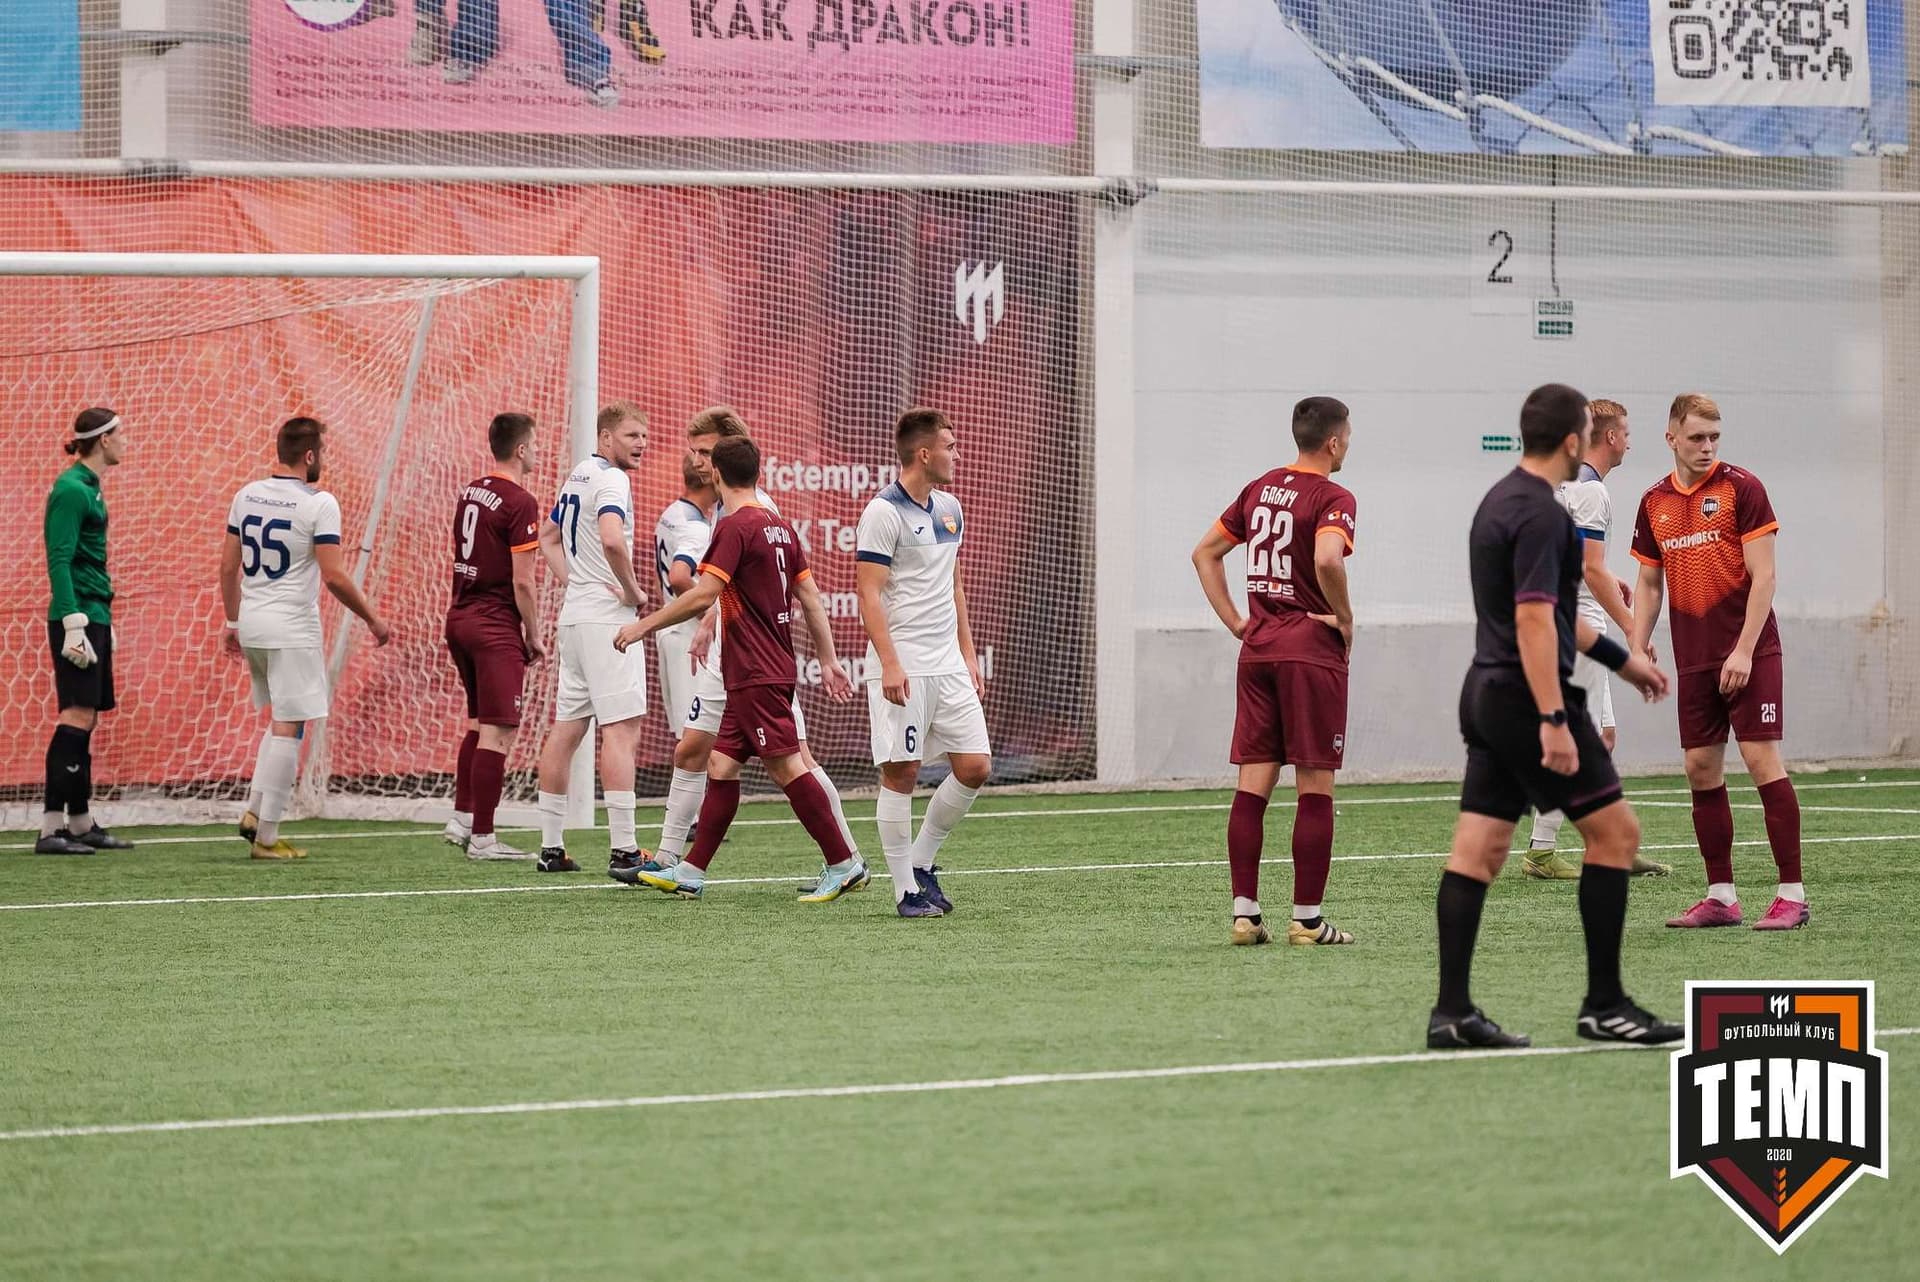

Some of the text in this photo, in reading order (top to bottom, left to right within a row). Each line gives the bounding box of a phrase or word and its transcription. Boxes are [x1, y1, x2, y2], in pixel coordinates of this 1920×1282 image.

[690, 0, 1031, 53] КАК ДРАКОН!
[1488, 230, 1513, 283] 2
[1260, 485, 1299, 508] БАБИЧ
[462, 503, 479, 560] 9
[1247, 506, 1293, 580] 22
[241, 514, 291, 580] 55
[1247, 580, 1294, 596] SEUS
[689, 696, 700, 722] 9
[1760, 702, 1776, 723] 25
[756, 727, 766, 747] 5
[905, 725, 918, 754] 6
